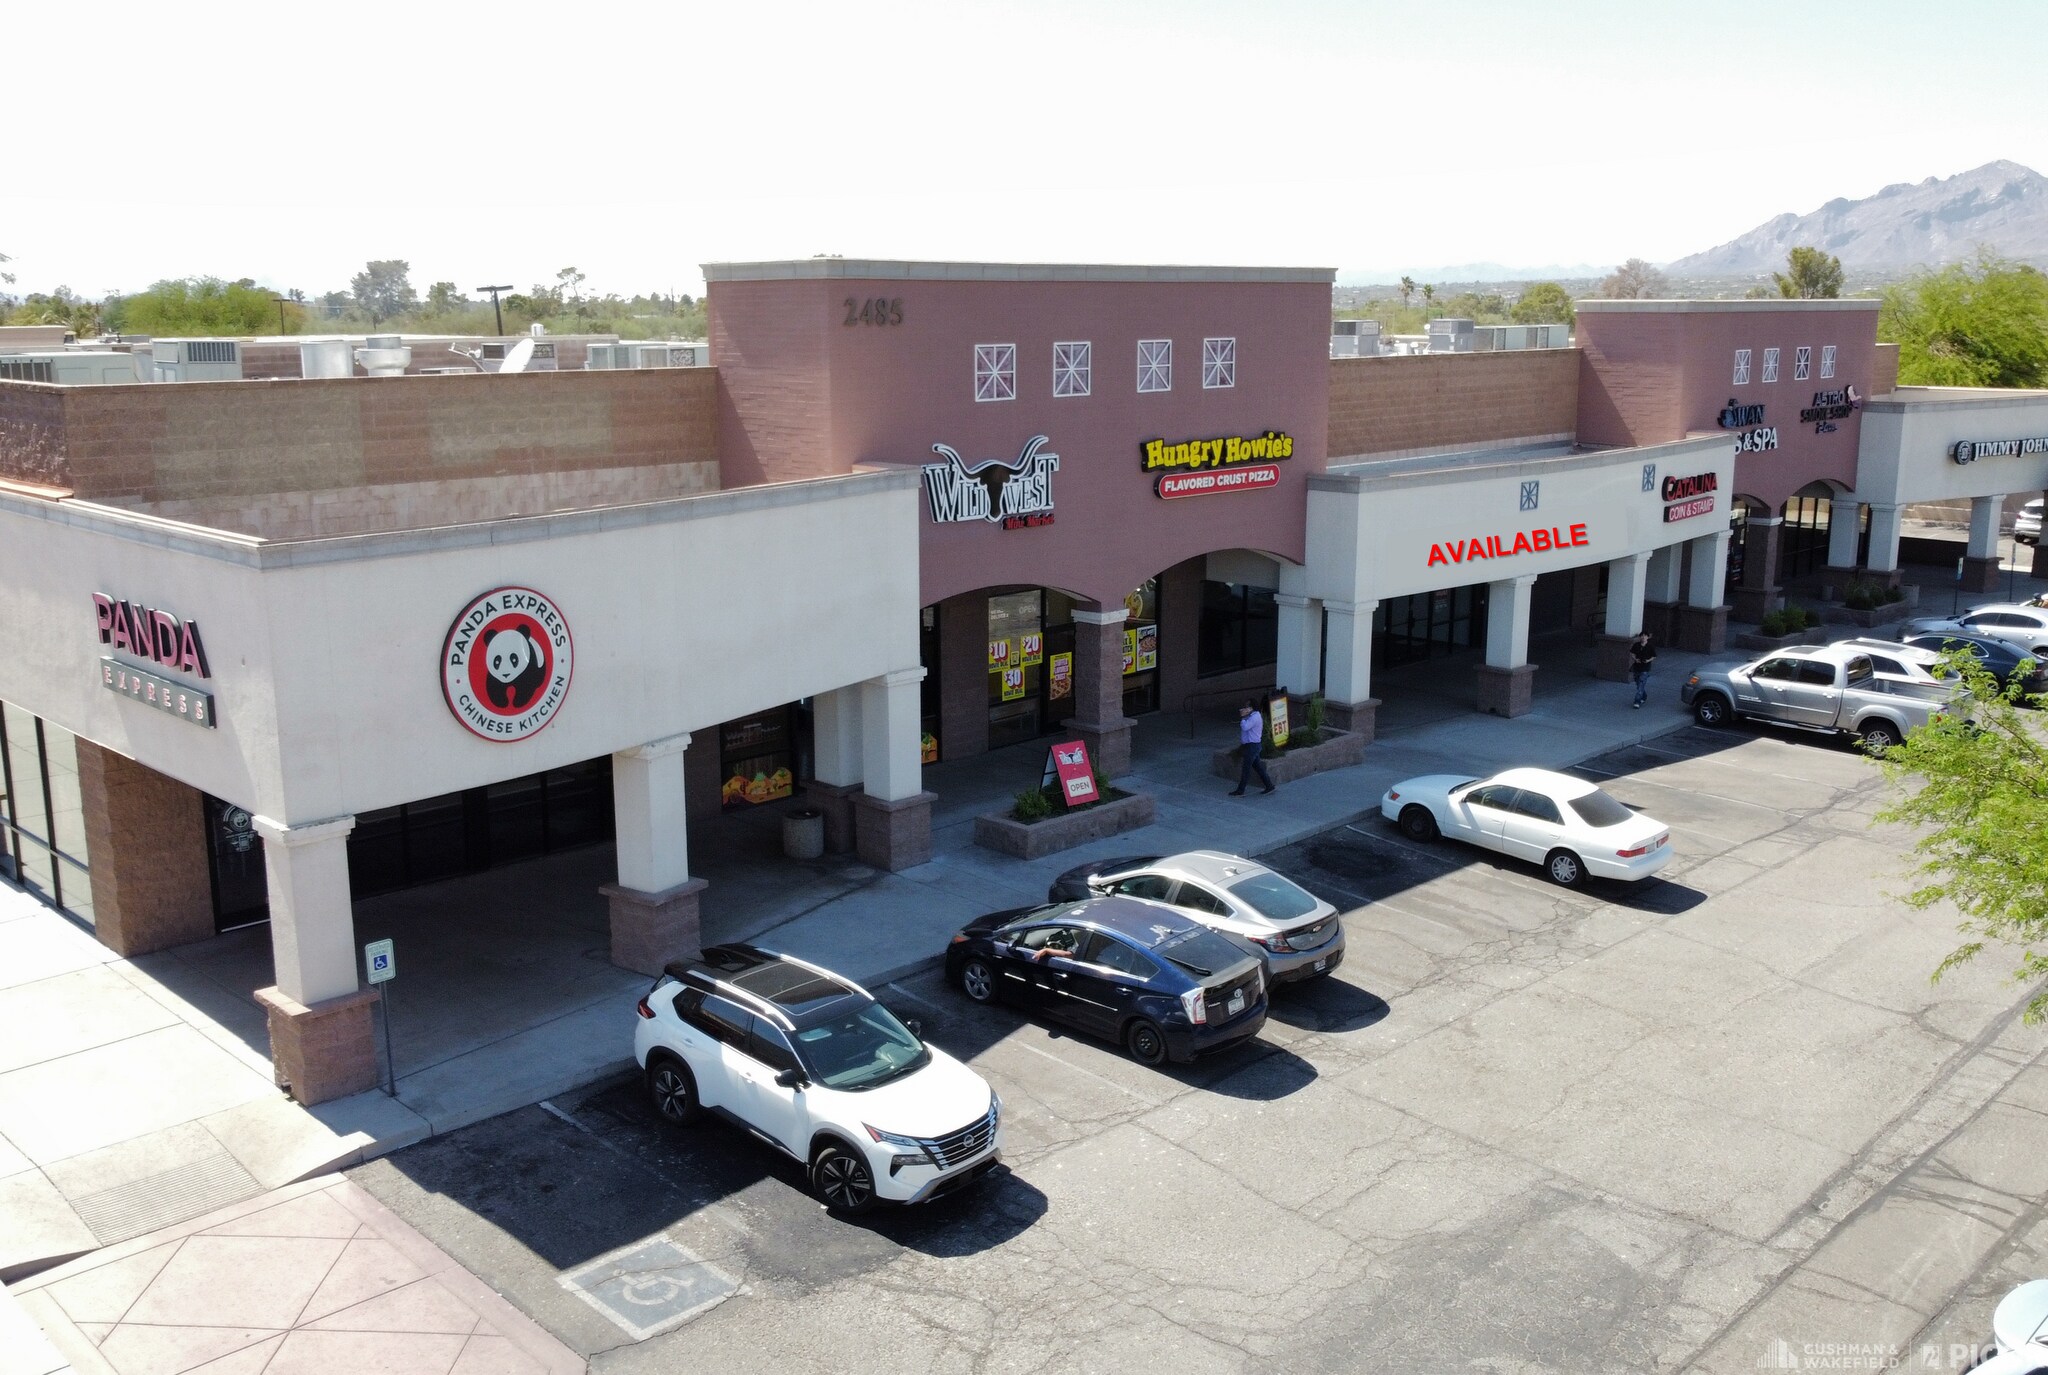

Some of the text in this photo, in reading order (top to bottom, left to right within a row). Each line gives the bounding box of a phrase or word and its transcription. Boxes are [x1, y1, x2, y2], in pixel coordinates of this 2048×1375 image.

[843, 298, 904, 327] 2485
[1812, 390, 1844, 407] ASTRO
[1146, 431, 1293, 469] Hungry Howie's
[1743, 433, 1753, 451] &
[1752, 427, 1778, 453] SPA
[1974, 440, 2020, 462] JIMMY
[1164, 469, 1276, 493] FLAVORED CRUST PIZZA
[1664, 472, 1717, 502] CATALINA
[1669, 505, 1686, 521] COIN
[1692, 498, 1714, 515] STAMP
[92, 592, 210, 679] PANDA
[451, 594, 566, 666] PANDA EXPRESS
[989, 641, 1007, 659] $10
[1022, 635, 1040, 653] $20
[1004, 668, 1021, 687] $30
[103, 666, 204, 719] EXPRESS
[459, 675, 565, 733] CHINESE KITCHEN
[1273, 720, 1287, 736] EBT
[1070, 781, 1090, 792] OPEN
